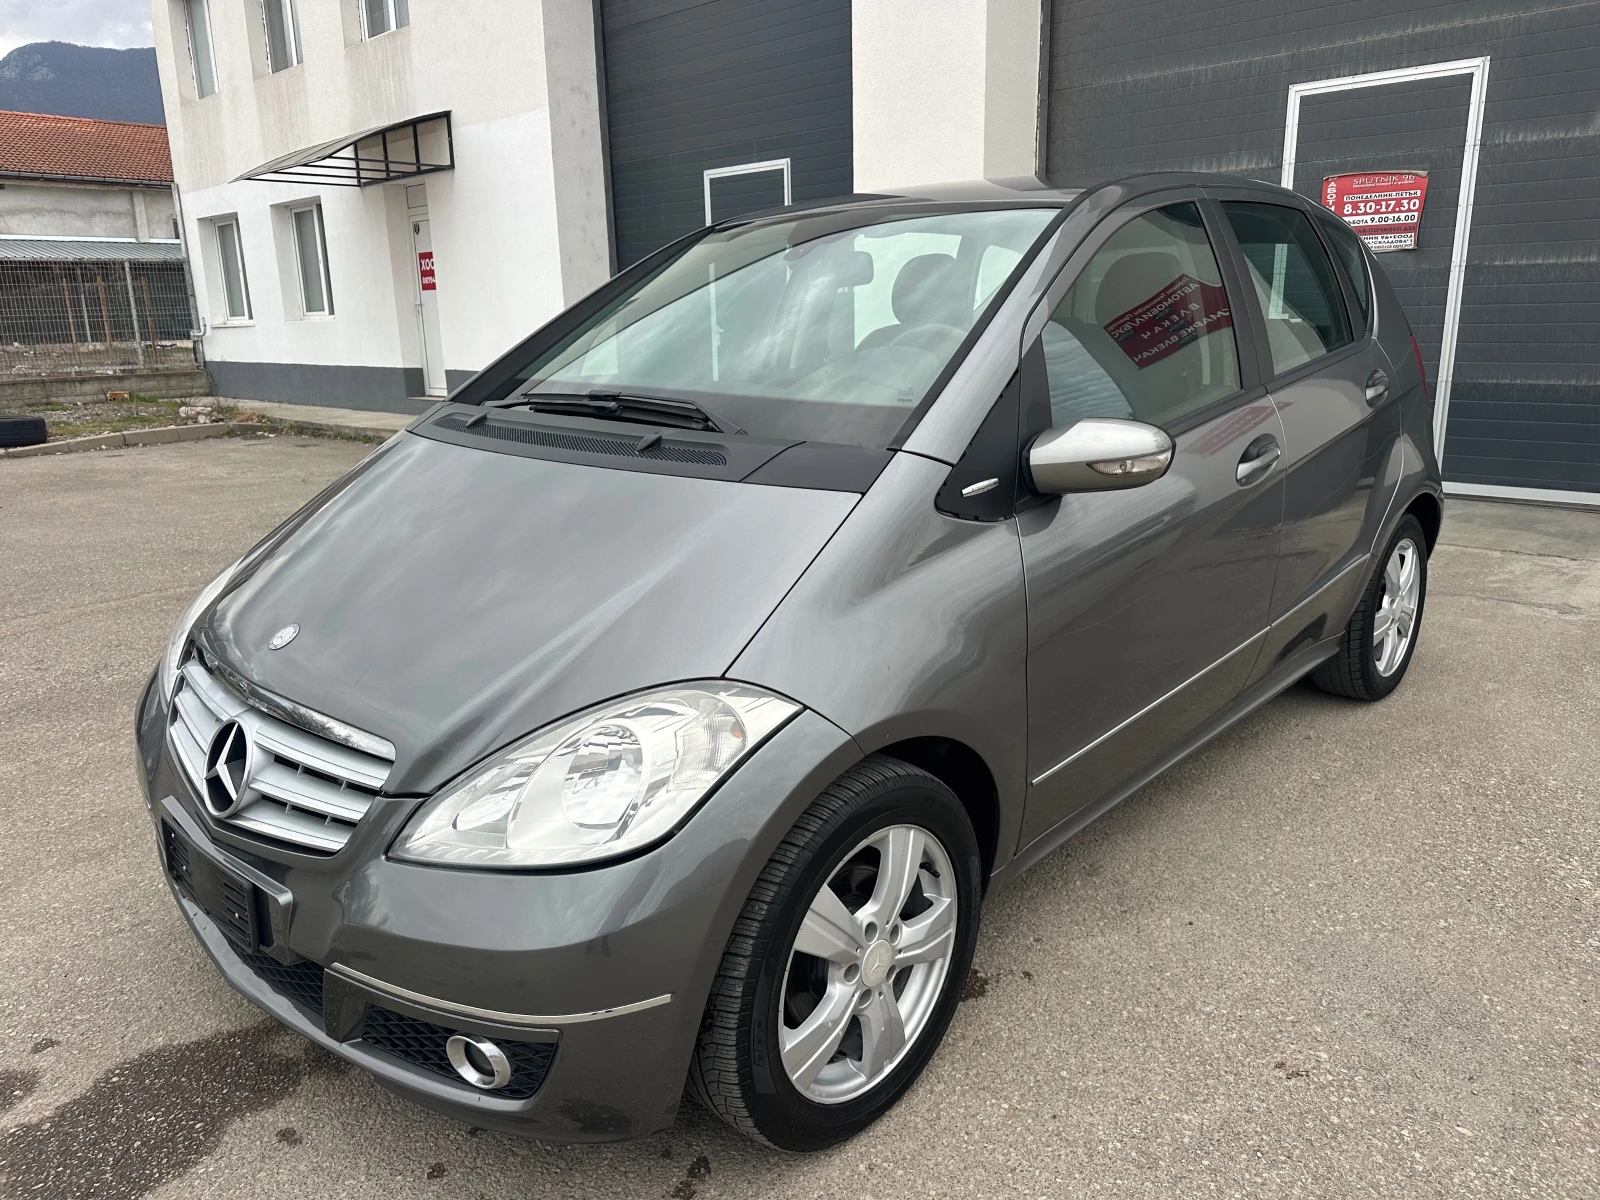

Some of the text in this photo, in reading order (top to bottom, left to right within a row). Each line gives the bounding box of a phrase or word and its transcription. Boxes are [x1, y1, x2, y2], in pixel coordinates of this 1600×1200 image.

[1353, 174, 1400, 185] SPUTNIK
[1345, 190, 1419, 201] ПОНЕДЕЛНИК-ПЕТЪК
[1343, 199, 1420, 215] 8.30-17.30
[1370, 214, 1416, 224] 9.00-16.00
